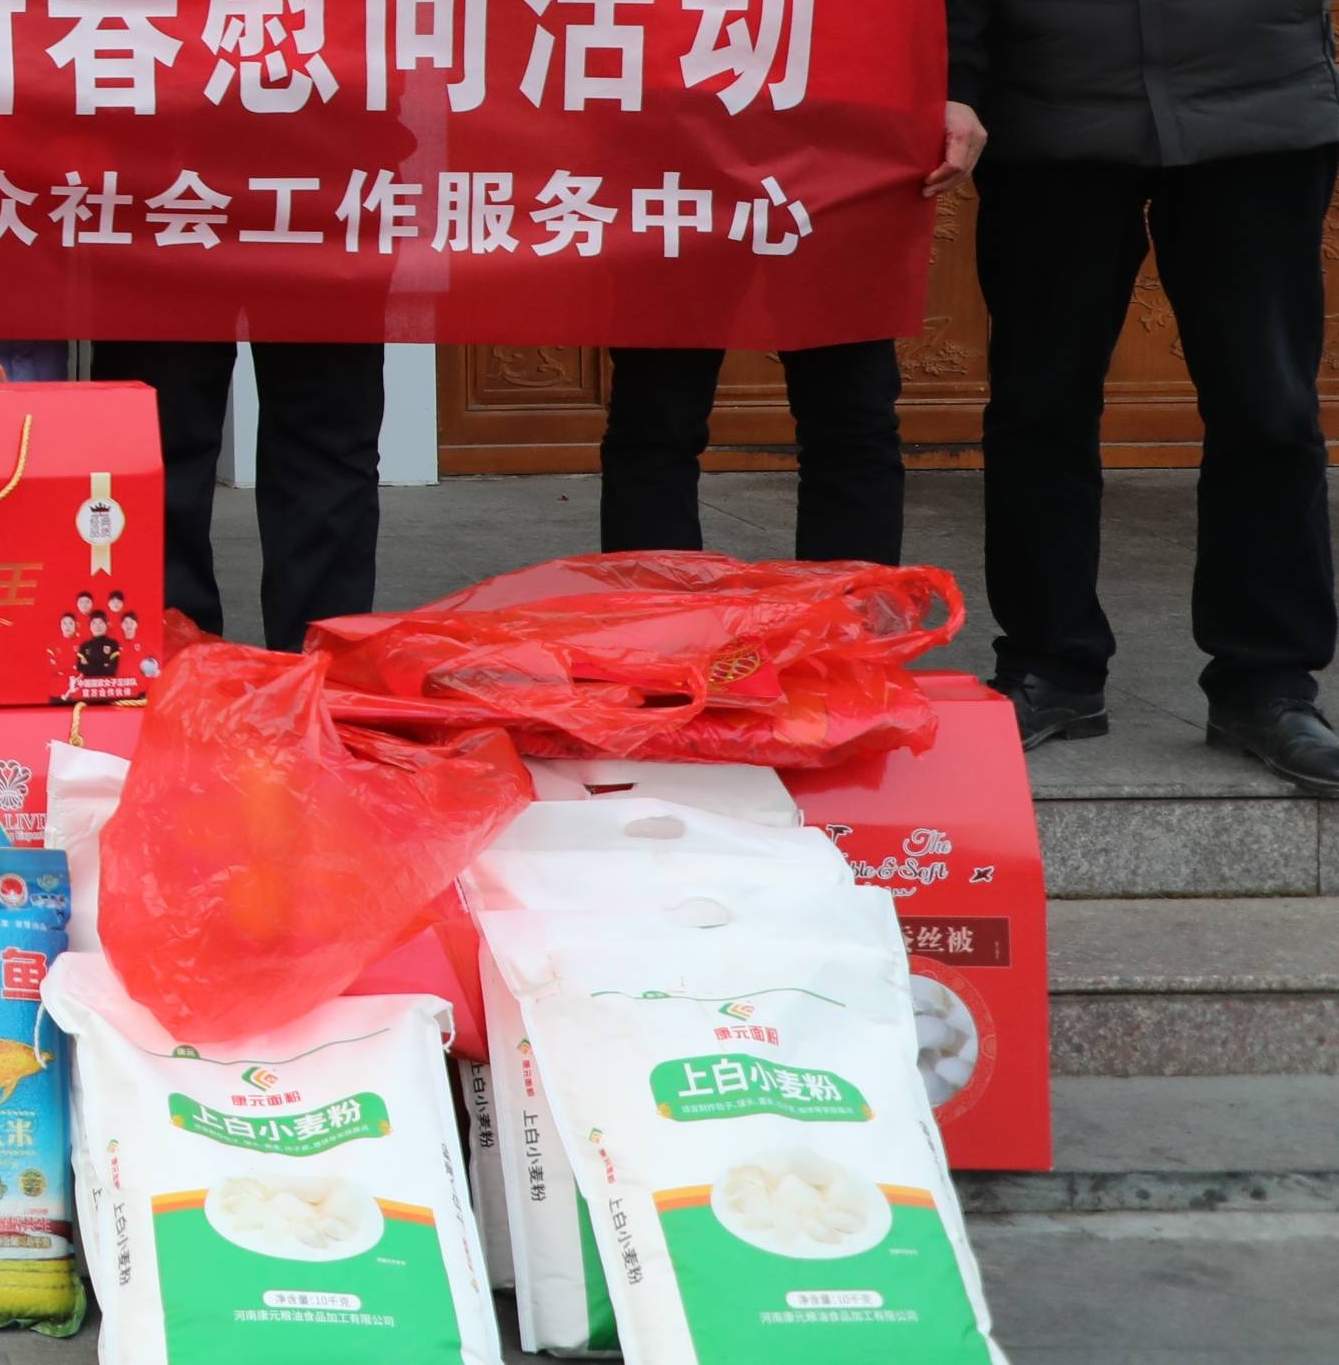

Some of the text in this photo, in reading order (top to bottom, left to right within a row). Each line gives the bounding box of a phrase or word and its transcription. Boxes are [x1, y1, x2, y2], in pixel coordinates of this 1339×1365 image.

[898, 857, 949, 885] Soft
[677, 1057, 842, 1102] 上白小麦粉
[193, 1098, 362, 1142] 上白小麦粉
[523, 1110, 547, 1203] 上白小麦粉
[607, 1197, 646, 1286] 上白小麦粉
